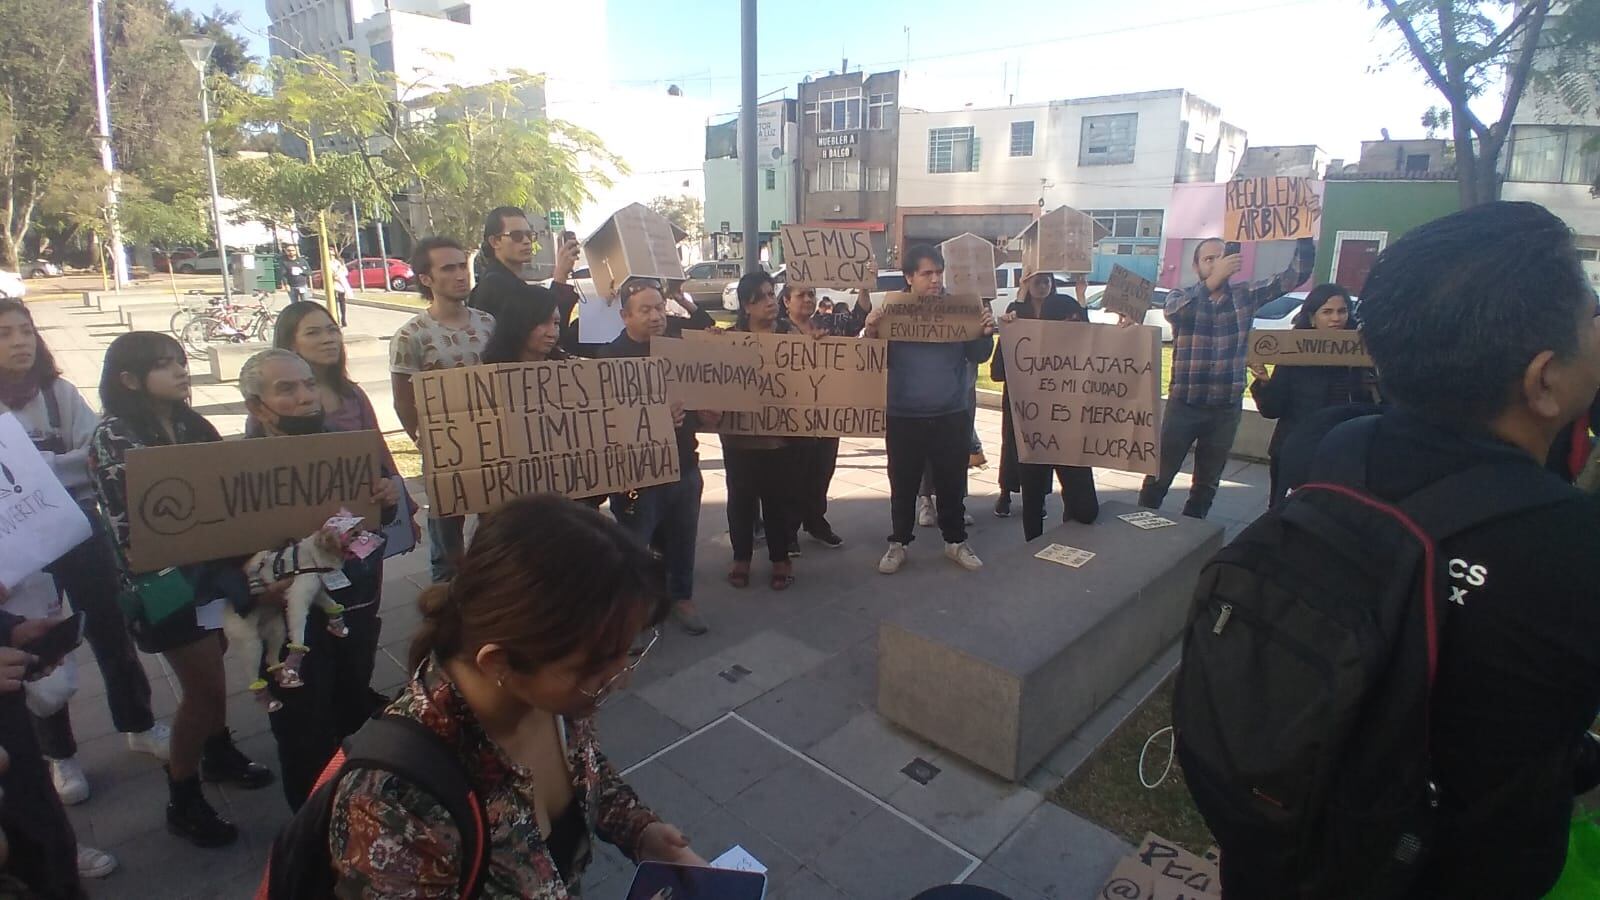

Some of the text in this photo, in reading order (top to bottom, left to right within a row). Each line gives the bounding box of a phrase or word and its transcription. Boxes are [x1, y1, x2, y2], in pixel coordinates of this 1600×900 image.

[785, 228, 871, 264] LEMUS
[890, 323, 968, 338] EQUITATIVA
[775, 340, 846, 371] GENTE
[856, 343, 884, 372] SIN
[423, 376, 455, 425] EL
[809, 374, 826, 402] Y
[1039, 378, 1128, 398] ES MI CIUDAD
[804, 407, 829, 432] SIN
[1014, 401, 1039, 422] NO
[1051, 404, 1071, 422] ES
[428, 425, 463, 470] ES
[476, 419, 516, 462] EL
[636, 407, 653, 443] A
[1021, 432, 1156, 463] ARA LUCRAR
[433, 472, 469, 517] LA
[480, 448, 599, 505] PROPIEDAD
